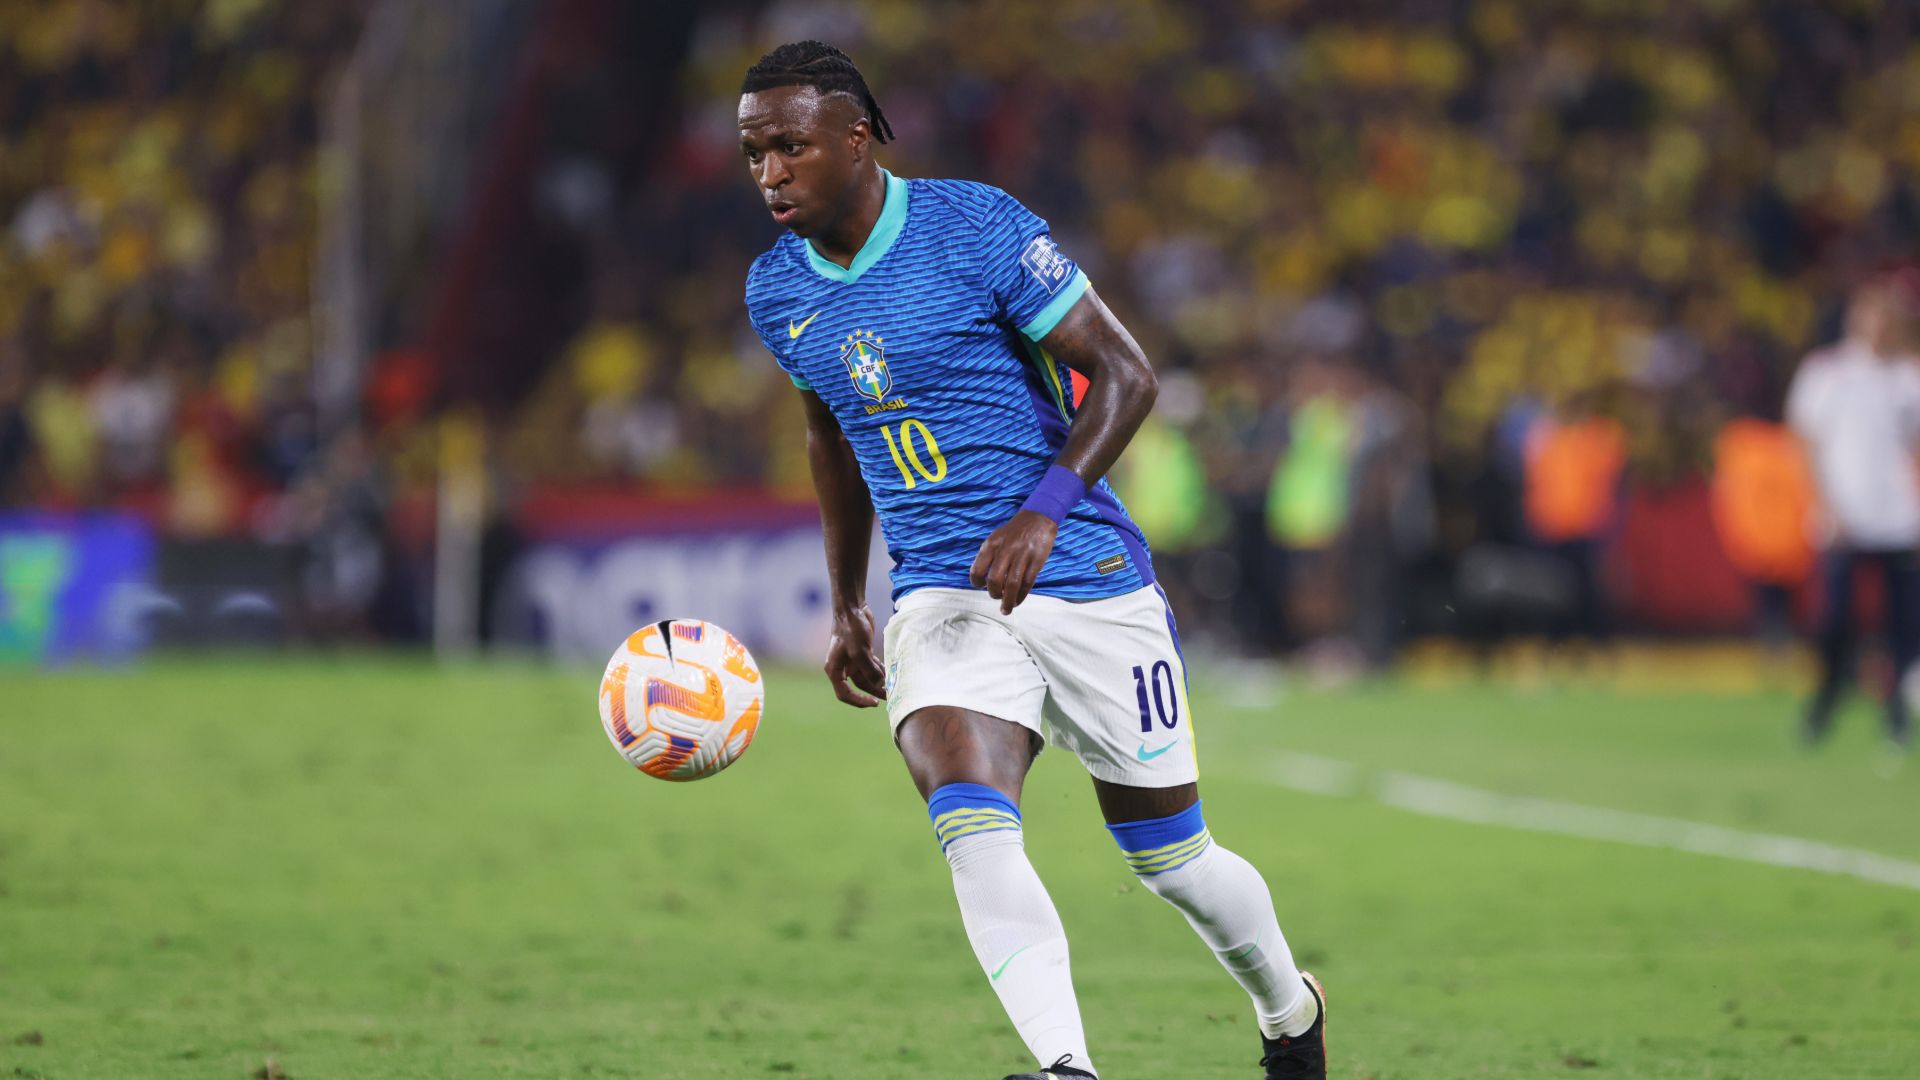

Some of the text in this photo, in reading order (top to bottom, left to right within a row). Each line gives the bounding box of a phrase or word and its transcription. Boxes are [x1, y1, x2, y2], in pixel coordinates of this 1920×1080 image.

[860, 364, 876, 374] CBF
[864, 398, 909, 415] BRASIL
[880, 418, 948, 490] 10
[1132, 660, 1178, 733] 10
